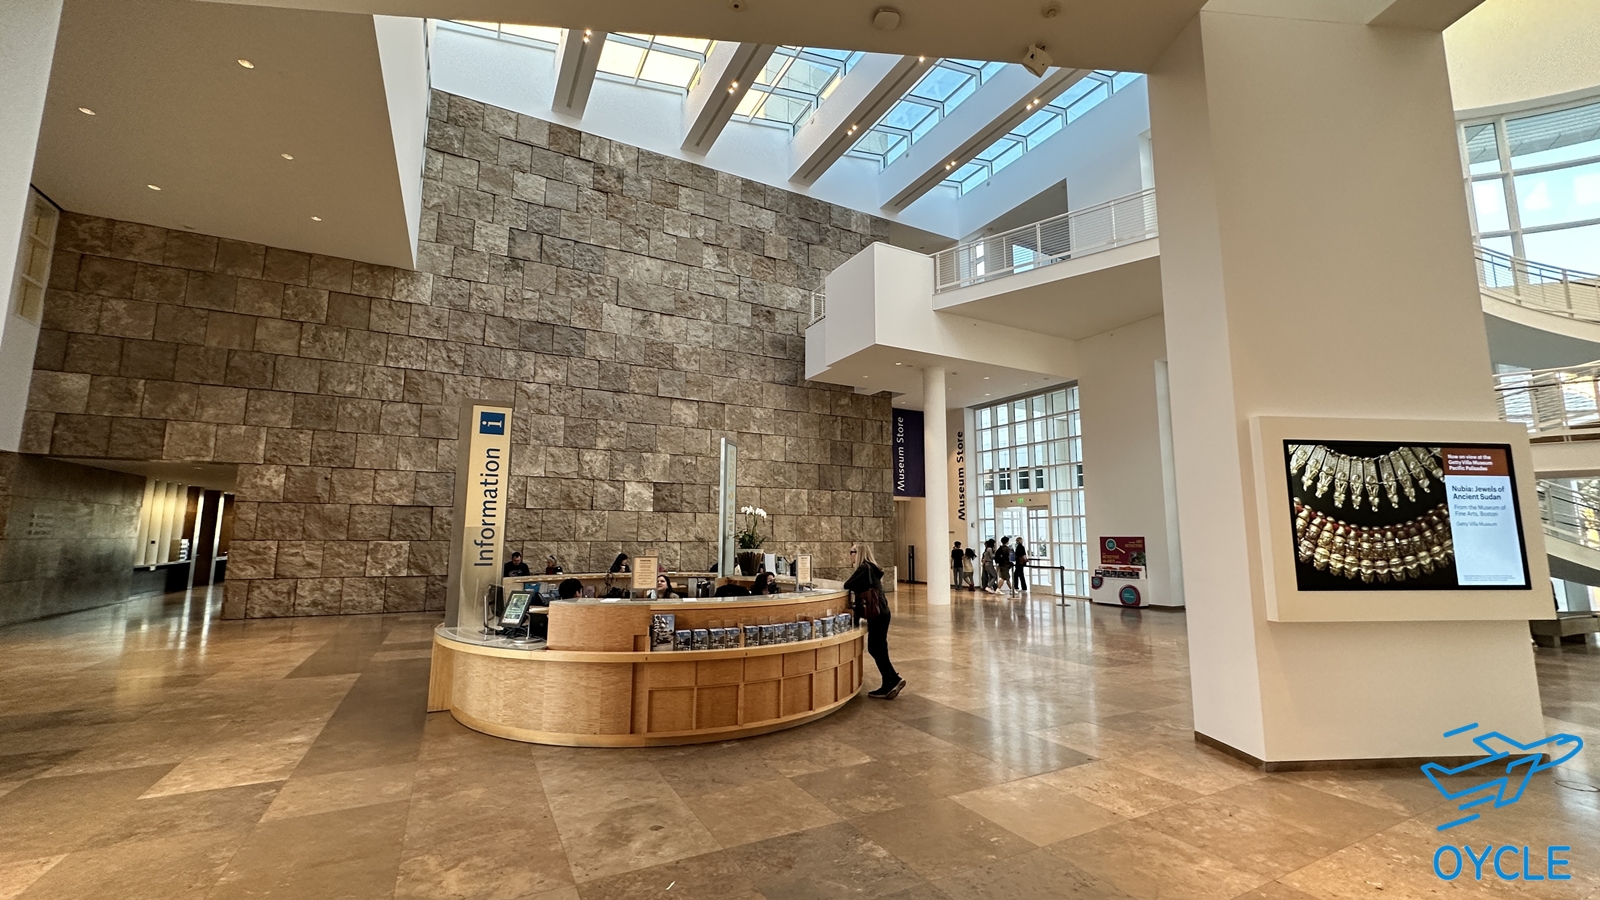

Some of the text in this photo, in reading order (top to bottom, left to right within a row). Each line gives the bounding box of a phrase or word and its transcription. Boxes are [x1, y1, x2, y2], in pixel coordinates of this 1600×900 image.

[896, 416, 905, 491] Museum Store
[474, 447, 501, 567] Information
[726, 505, 734, 540] Talks
